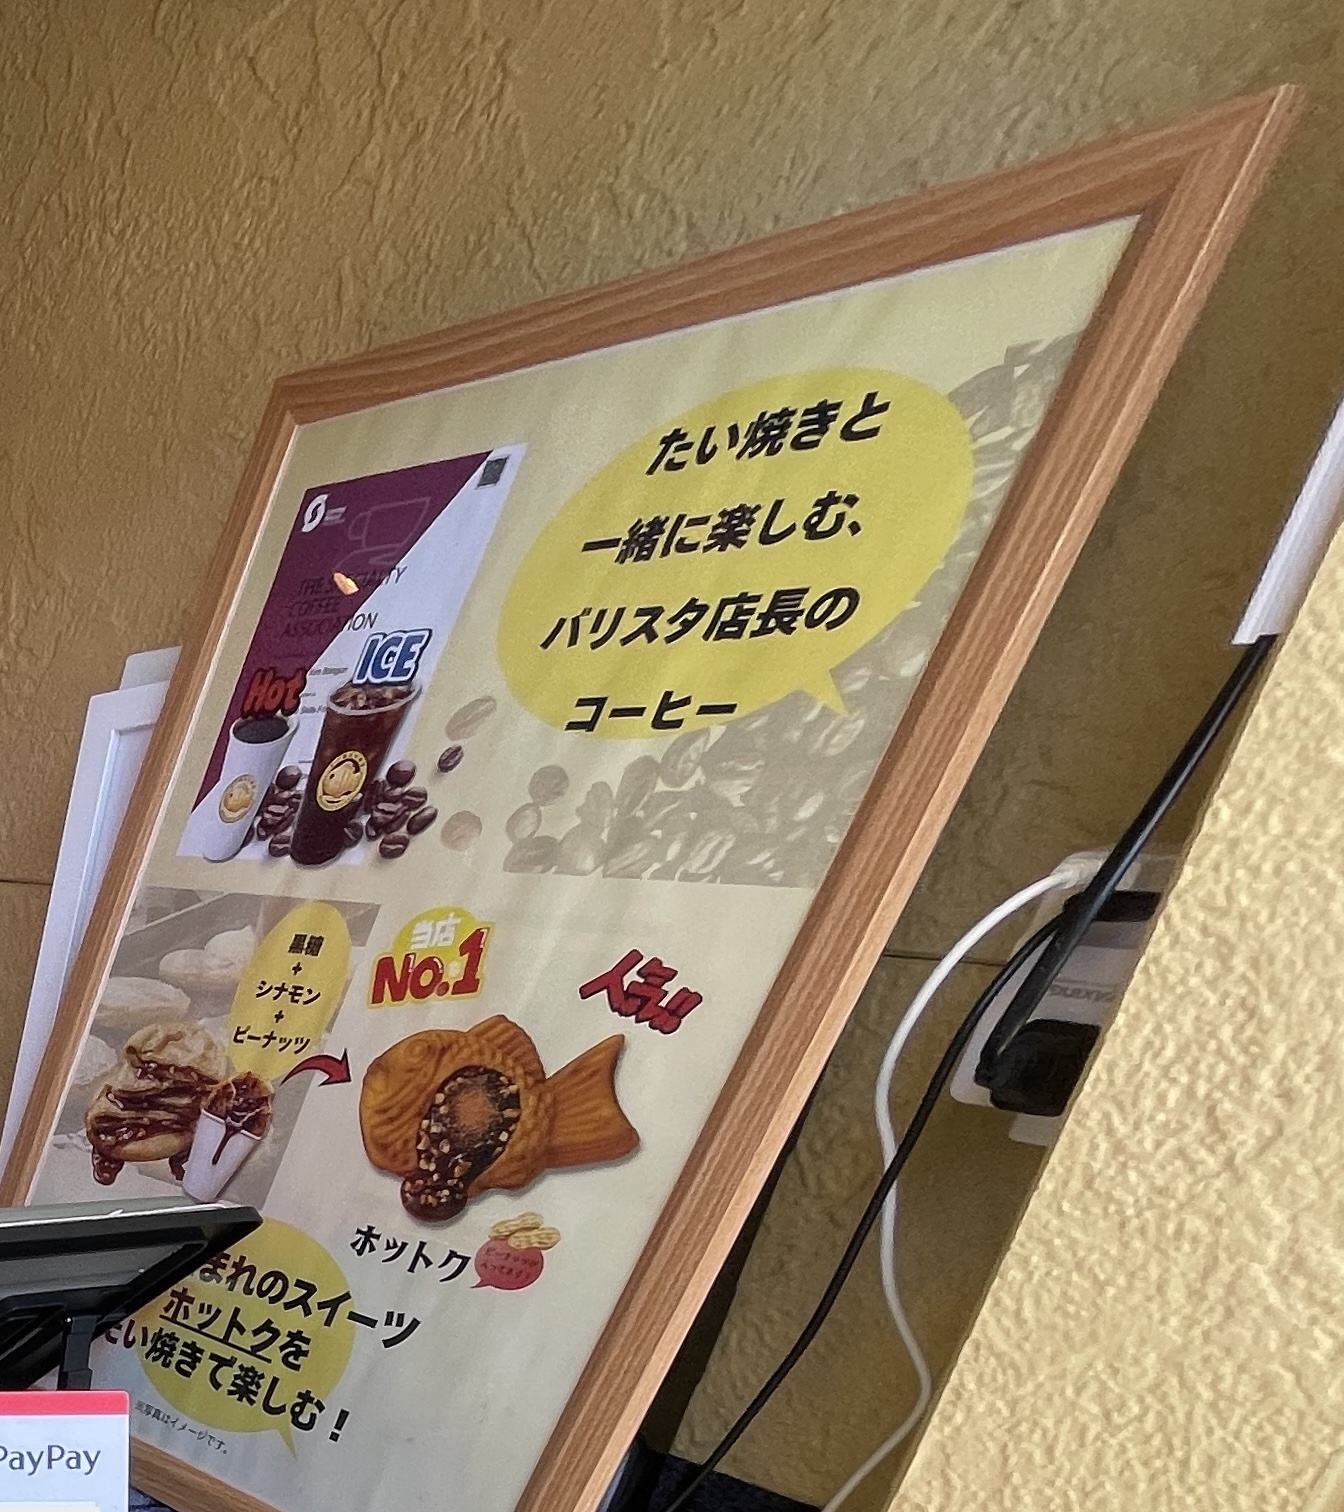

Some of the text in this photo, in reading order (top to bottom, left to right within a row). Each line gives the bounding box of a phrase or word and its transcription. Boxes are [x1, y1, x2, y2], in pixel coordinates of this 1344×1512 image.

[645, 391, 891, 476] たい焼きと
[581, 491, 861, 565] 一緒に楽しむ、
[539, 586, 860, 651] バリスタ店長の
[355, 629, 432, 686] ICE
[565, 690, 738, 733] コーヒー
[255, 980, 321, 1006] シナモン
[233, 1025, 311, 1055] ピーナッツ
[350, 1224, 472, 1282] ホットク
[161, 1286, 312, 1372] ホットクを
[194, 1251, 421, 1349] まれのスイーツ
